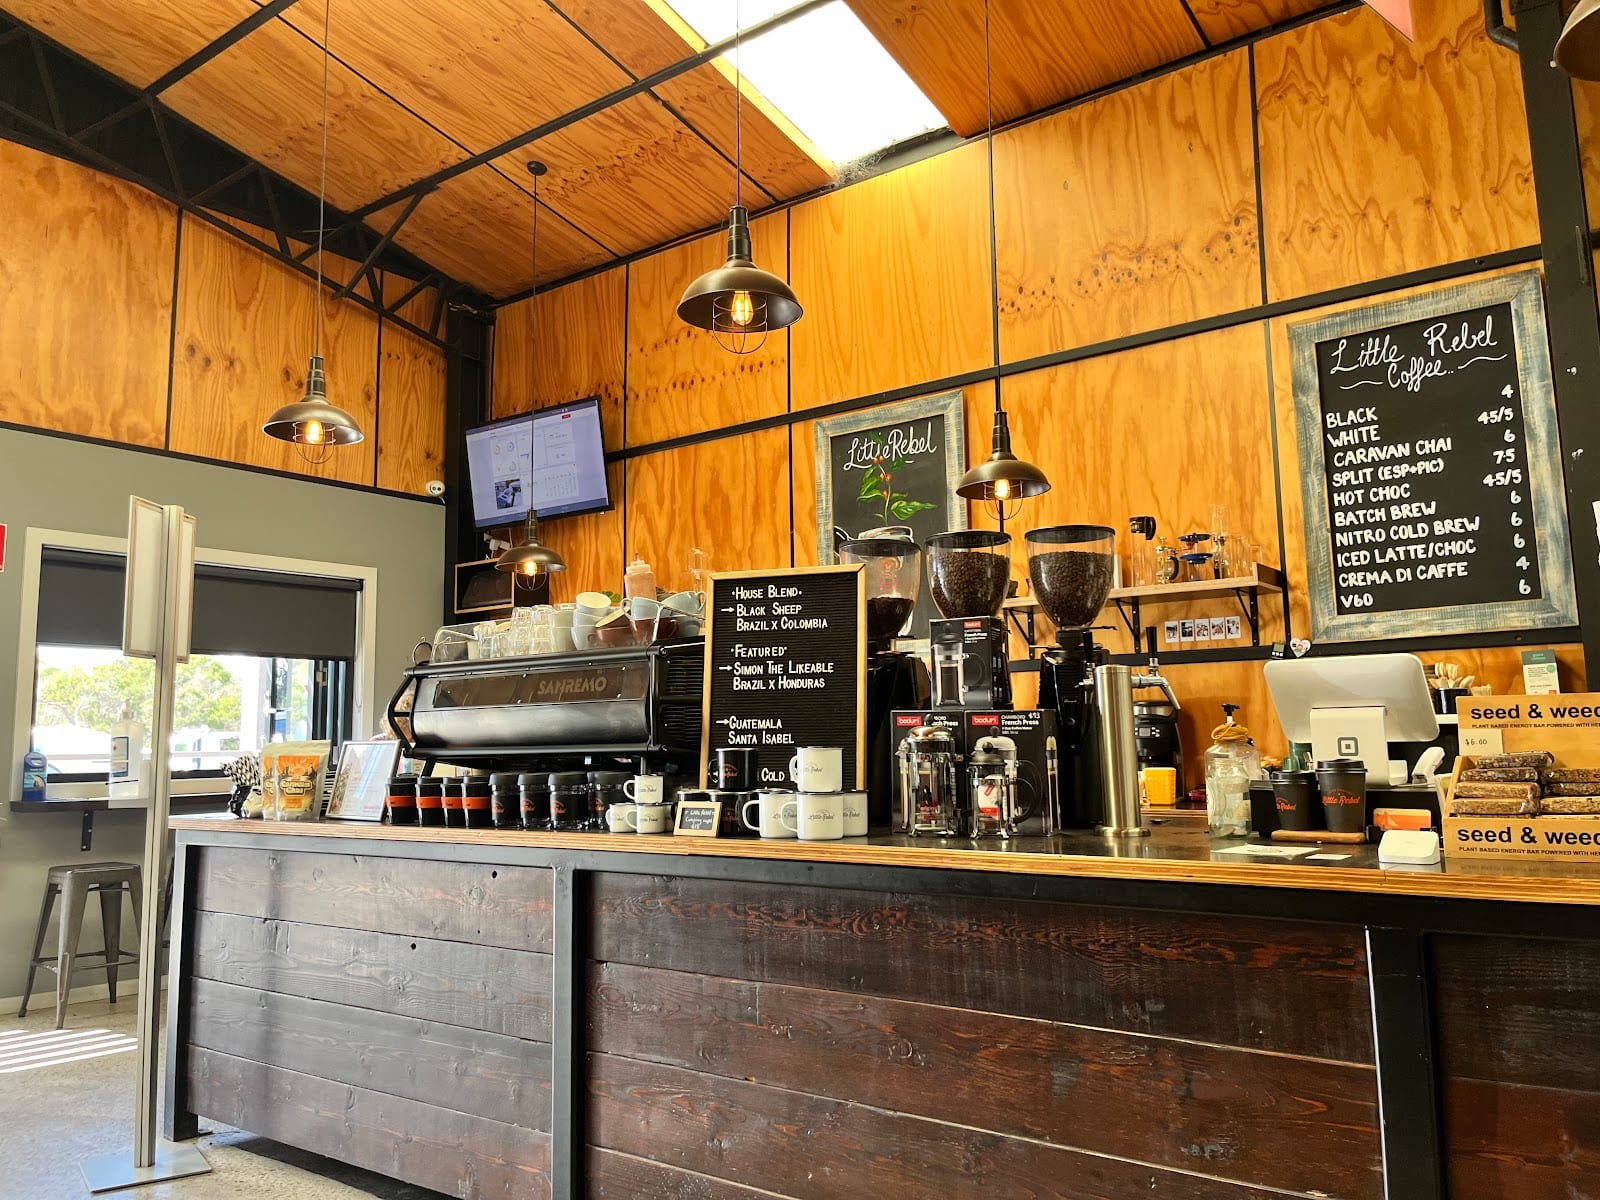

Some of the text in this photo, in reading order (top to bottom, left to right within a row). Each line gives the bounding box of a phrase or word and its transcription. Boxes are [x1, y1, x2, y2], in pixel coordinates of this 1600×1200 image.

[1330, 315, 1498, 375] Little Rebel
[1501, 384, 1514, 398] 4
[1326, 406, 1379, 430] BLACK
[887, 421, 938, 462] Rebel
[1327, 424, 1516, 448] WHITE 6
[1333, 442, 1411, 468] CARAVAN
[1415, 437, 1453, 456] CHAI
[1332, 467, 1374, 487] SPLIT
[1333, 483, 1522, 507] HOT CHOC 6
[1334, 500, 1523, 528] BATCH BREW 6
[1335, 515, 1526, 549] NITRO COLD BREW 6
[1336, 538, 1530, 570] ICED LATTE/CHOC 4
[1338, 561, 1532, 595] CREMA DI CAFFE 6
[735, 584, 799, 600] HOUSE BLEND
[736, 602, 802, 617] BLACK SHEEP
[1340, 593, 1374, 610] V60
[736, 618, 769, 632] BRAZIL
[780, 616, 828, 630] COLOMBIA
[735, 644, 785, 658] FEATURED
[733, 660, 834, 675] SIMON THE LIKEABLE
[537, 675, 607, 696] SANREMO
[733, 676, 766, 690] BRAZIL
[778, 675, 825, 689] HONDURAS
[1471, 704, 1520, 720] seed
[1528, 703, 1544, 719] &
[728, 715, 782, 729] GUATEMALA
[728, 731, 794, 745] SANTA ISABEL
[761, 767, 785, 782] COLD
[1458, 826, 1512, 843] seed
[1520, 826, 1538, 844] &
